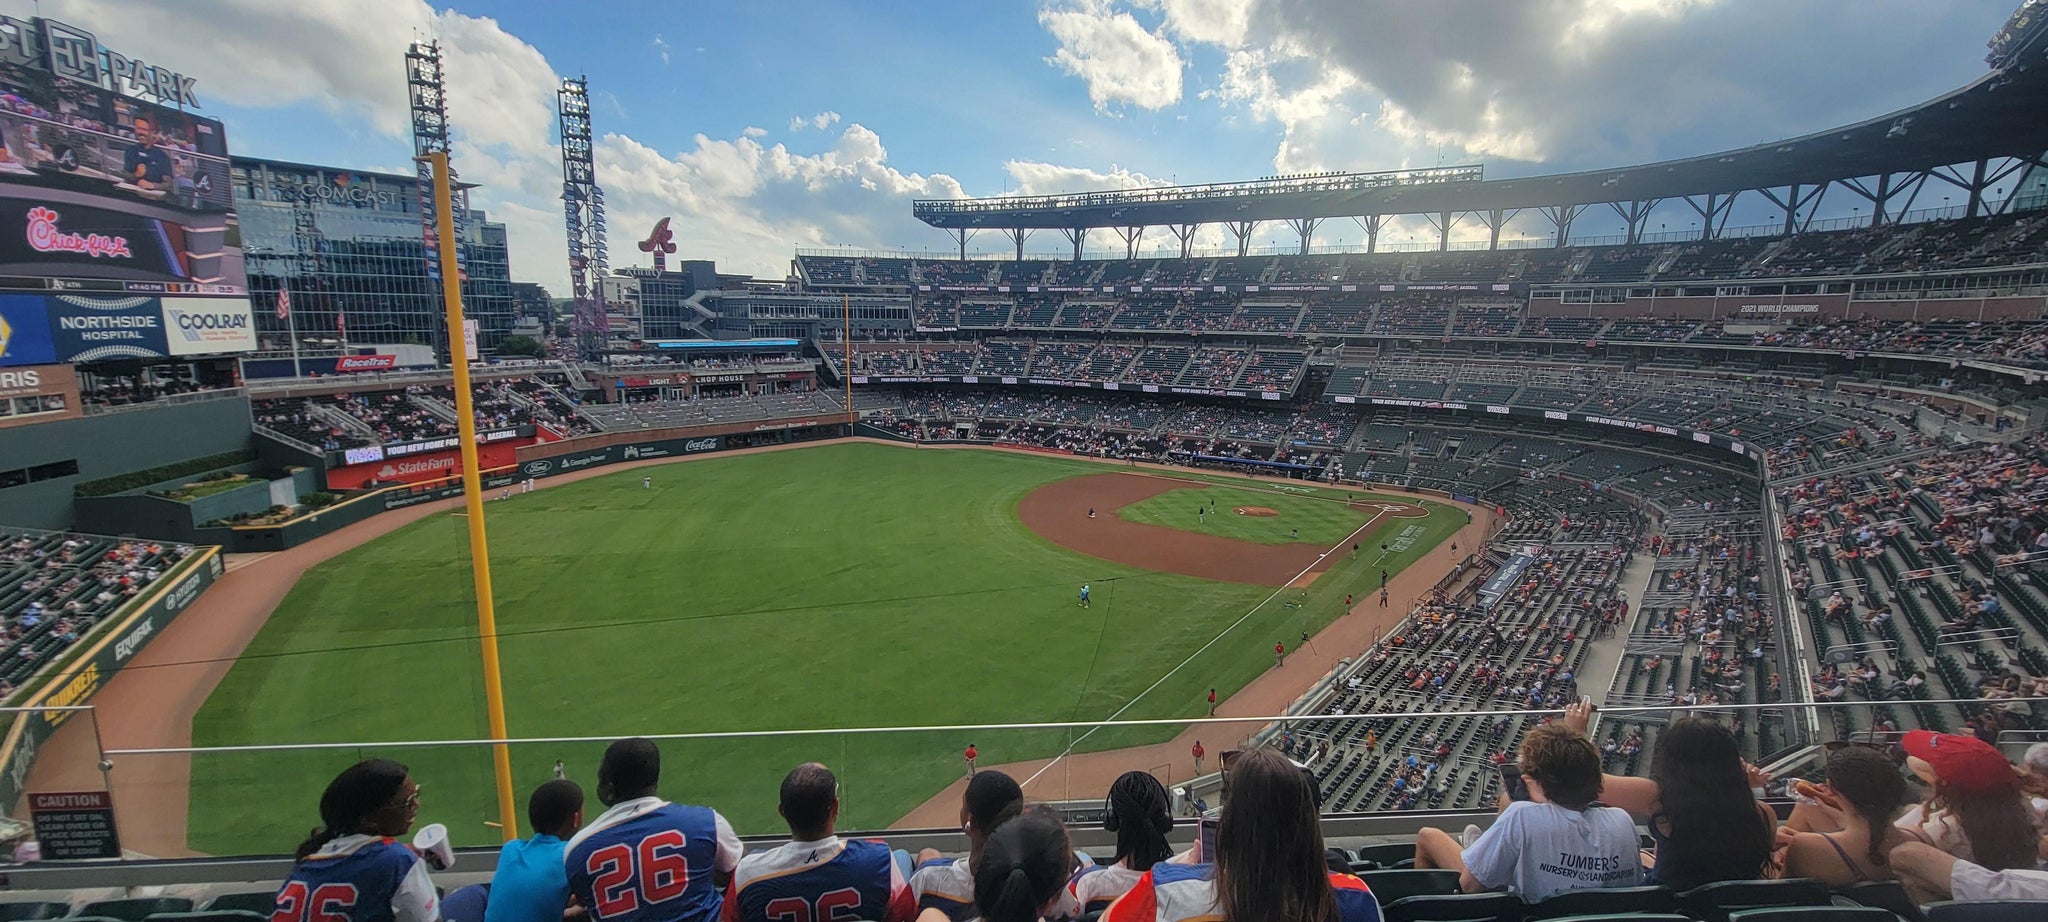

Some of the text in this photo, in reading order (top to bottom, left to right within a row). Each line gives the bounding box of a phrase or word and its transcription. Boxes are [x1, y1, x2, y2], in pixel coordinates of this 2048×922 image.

[108, 49, 201, 109] PARK
[300, 183, 397, 205] COMCAST
[1757, 304, 1780, 312] WORLD
[1782, 304, 1819, 313] CHAMPIONS
[60, 316, 158, 330] NORTHSIDE
[178, 314, 248, 330] COOLRAY
[82, 331, 144, 340] HOSPITAL
[341, 357, 390, 369] RaceTrac
[718, 374, 744, 382] HOUSE
[387, 430, 517, 455] YOUR NEW HOME FOR BASEBALL
[528, 462, 548, 473] Ford
[570, 458, 590, 466] Georgia
[176, 573, 201, 602] HYUNDAI
[114, 616, 153, 662] EQUIFAX
[36, 794, 100, 807] CAUTION
[1560, 852, 1620, 871] TUMBER'S
[586, 829, 689, 919] 26
[1540, 863, 1578, 879] NURSERY
[270, 880, 359, 922] 26
